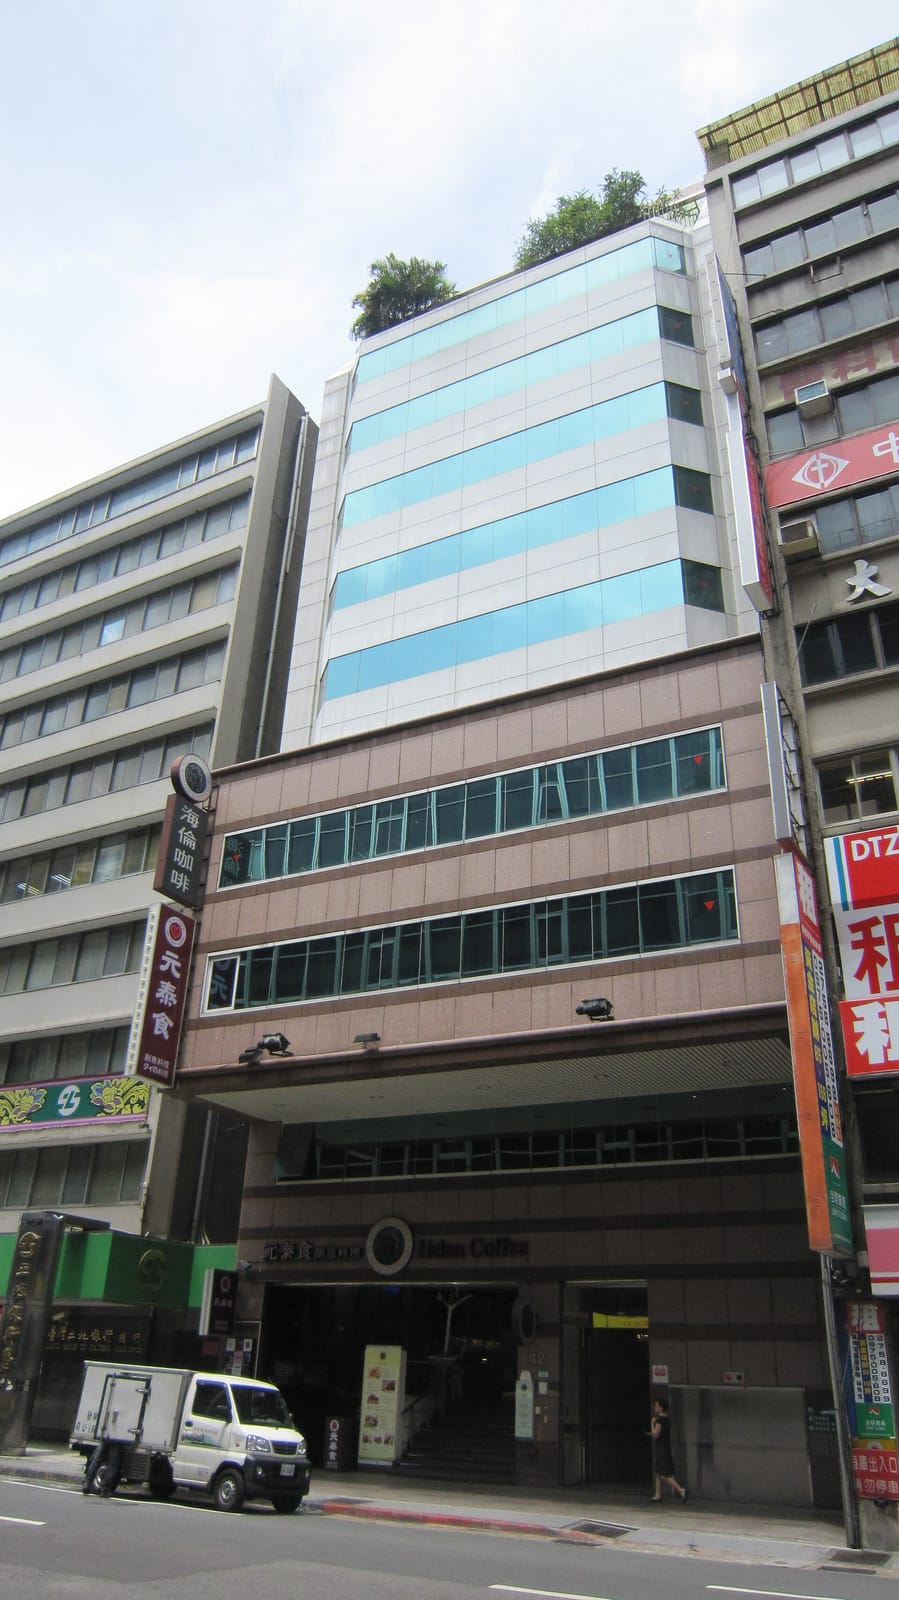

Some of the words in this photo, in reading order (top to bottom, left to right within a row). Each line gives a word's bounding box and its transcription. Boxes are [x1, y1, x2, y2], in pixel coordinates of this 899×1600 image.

[170, 804, 200, 893] 海倫咖啡
[851, 833, 899, 861] DTZ
[152, 950, 182, 1040] 元泰食
